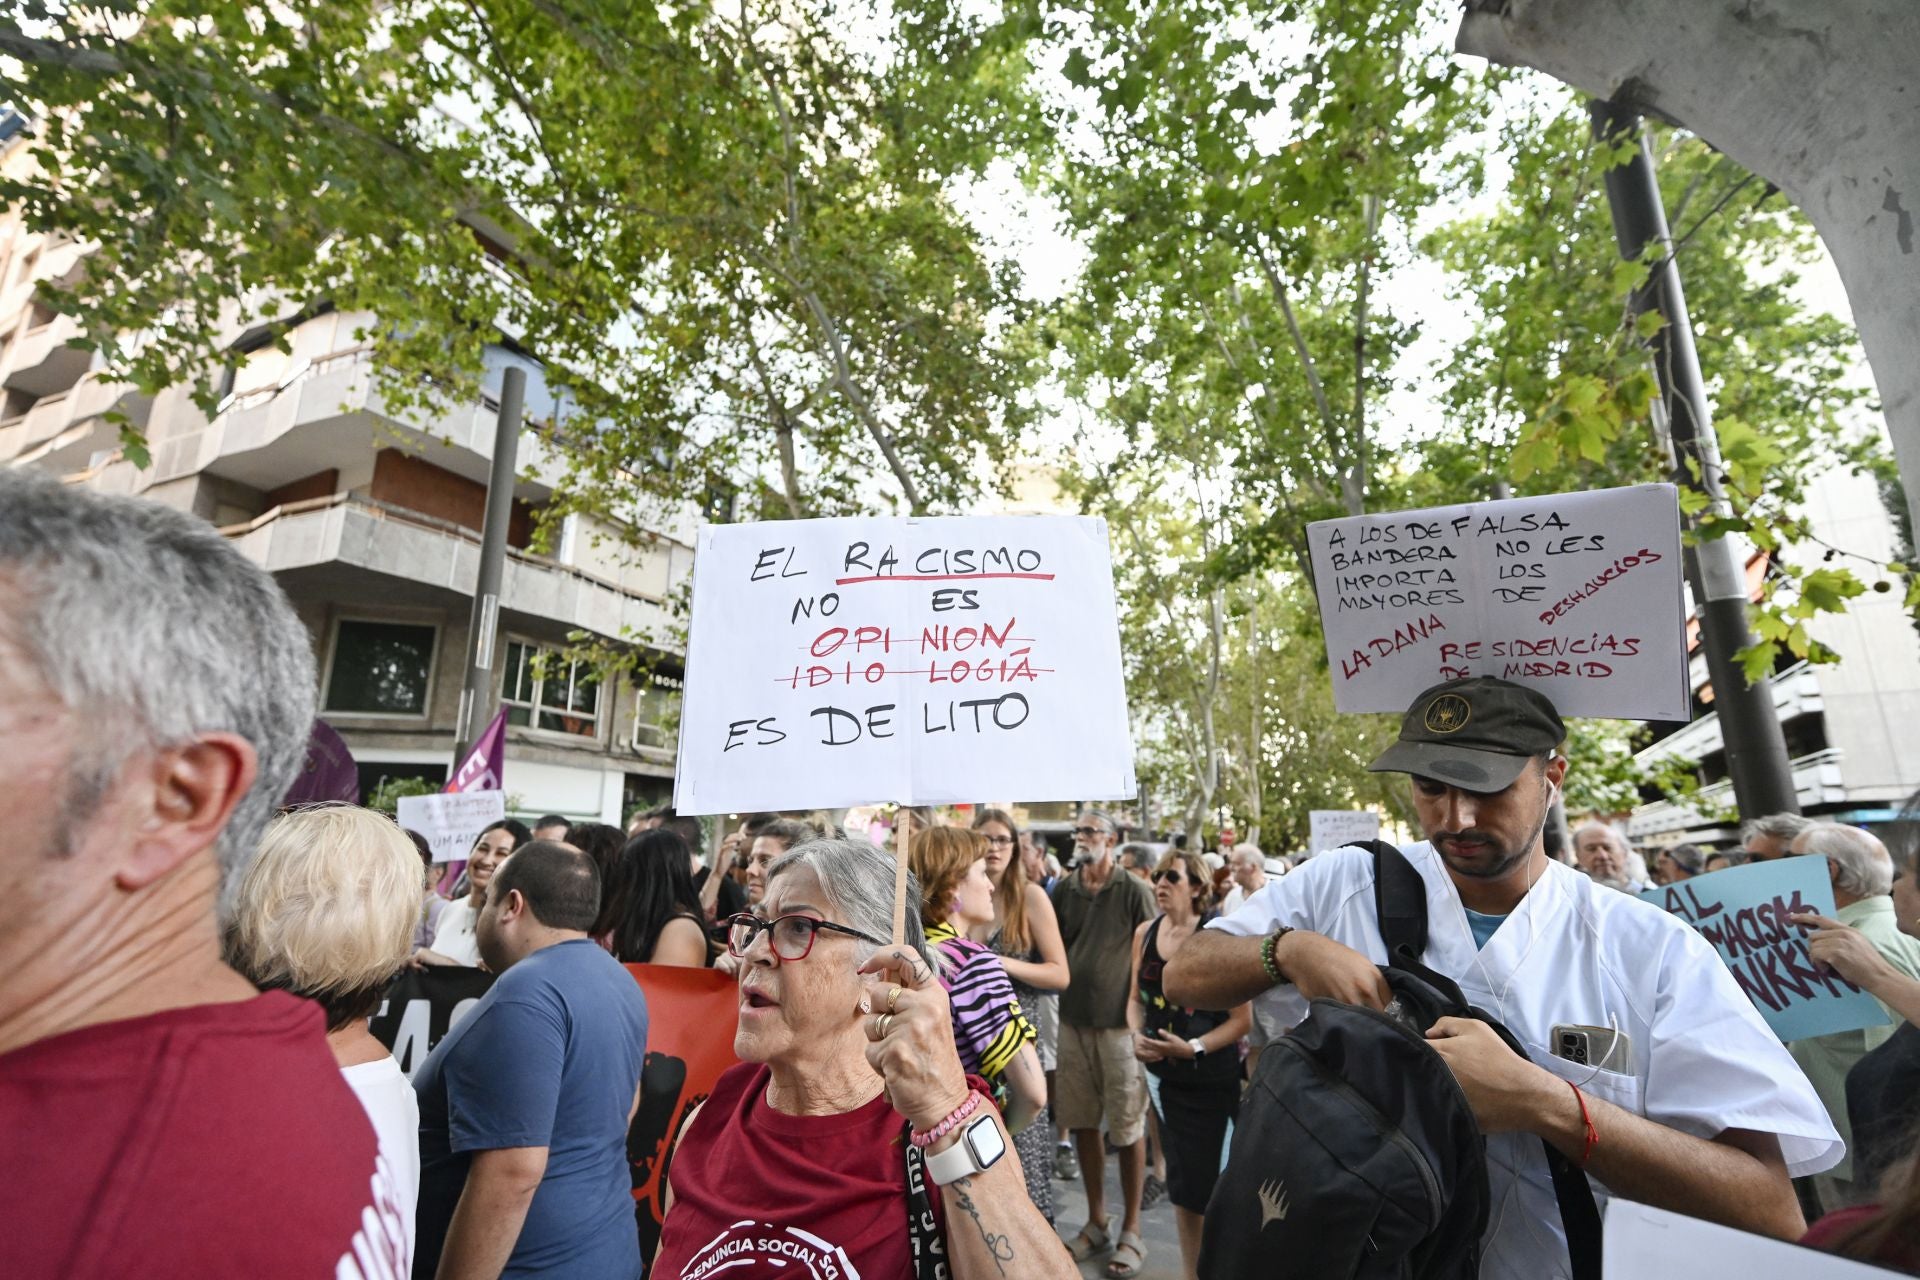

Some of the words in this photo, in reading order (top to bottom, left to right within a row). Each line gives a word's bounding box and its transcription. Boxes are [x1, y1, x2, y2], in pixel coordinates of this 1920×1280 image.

[1329, 527, 1346, 549] A
[1360, 524, 1398, 545] LOS
[1404, 522, 1442, 540] DE
[1330, 545, 1457, 571] BANDERA
[1495, 540, 1531, 558] NO
[1545, 534, 1606, 556] LES
[750, 545, 808, 582] EL
[1336, 568, 1457, 595] IMPORTA
[1499, 563, 1547, 580] LOS
[791, 591, 840, 624] NO
[931, 588, 981, 613] ES
[1338, 589, 1465, 613] MAYORES
[1491, 586, 1547, 603] DE
[1439, 666, 1471, 680] DE
[1503, 660, 1613, 680] MADRID
[722, 716, 788, 752] ES
[1664, 883, 1724, 922] AL
